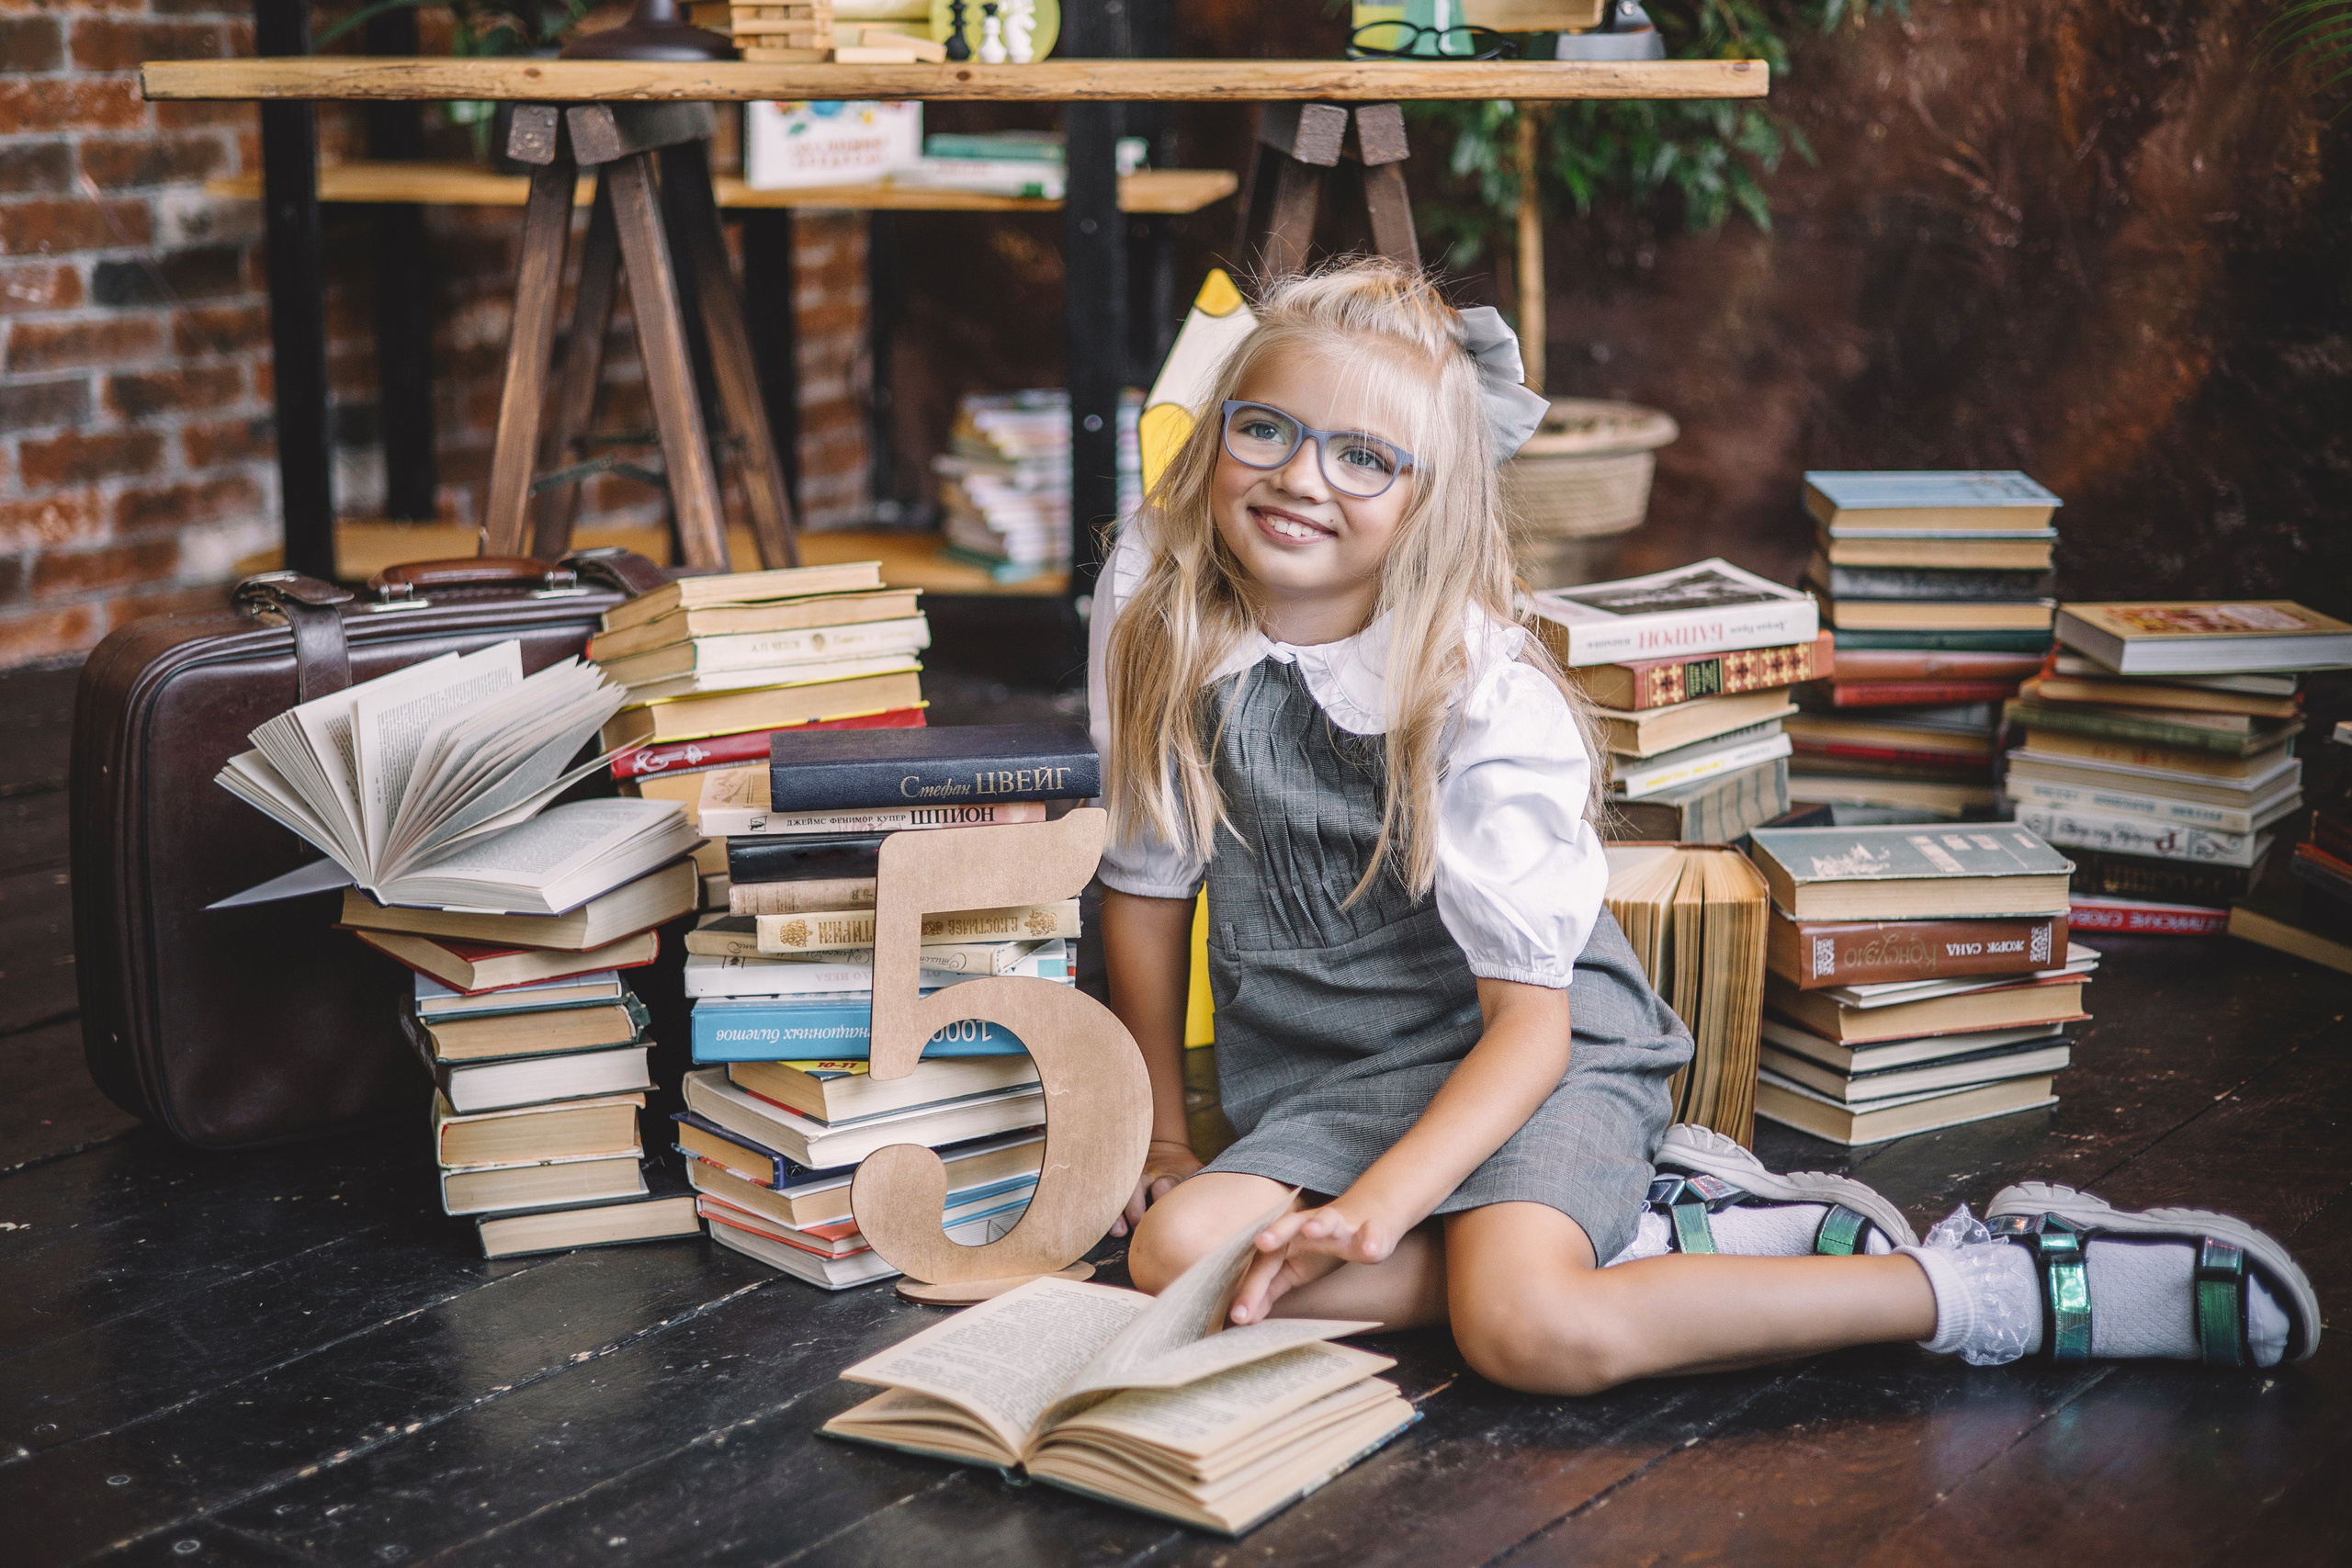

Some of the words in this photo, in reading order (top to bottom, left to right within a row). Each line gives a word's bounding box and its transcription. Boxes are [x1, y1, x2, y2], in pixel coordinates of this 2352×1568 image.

[899, 775, 971, 798] Стефан
[975, 765, 1071, 796] ЦВЕЙГ
[786, 818, 827, 827] ДЖЕЙМС
[829, 816, 874, 825] ФЕНИМОР
[876, 814, 907, 823] КУПЕР
[910, 807, 995, 826] ШПИОН
[818, 919, 876, 944] ТИРИМ
[1945, 941, 1983, 956] САНД
[1986, 939, 2025, 953] ЖОРЖ
[815, 972, 850, 983] НЕБА
[716, 1027, 780, 1044] билетов
[784, 1024, 870, 1042] национных
[851, 807, 1154, 1286] 5
